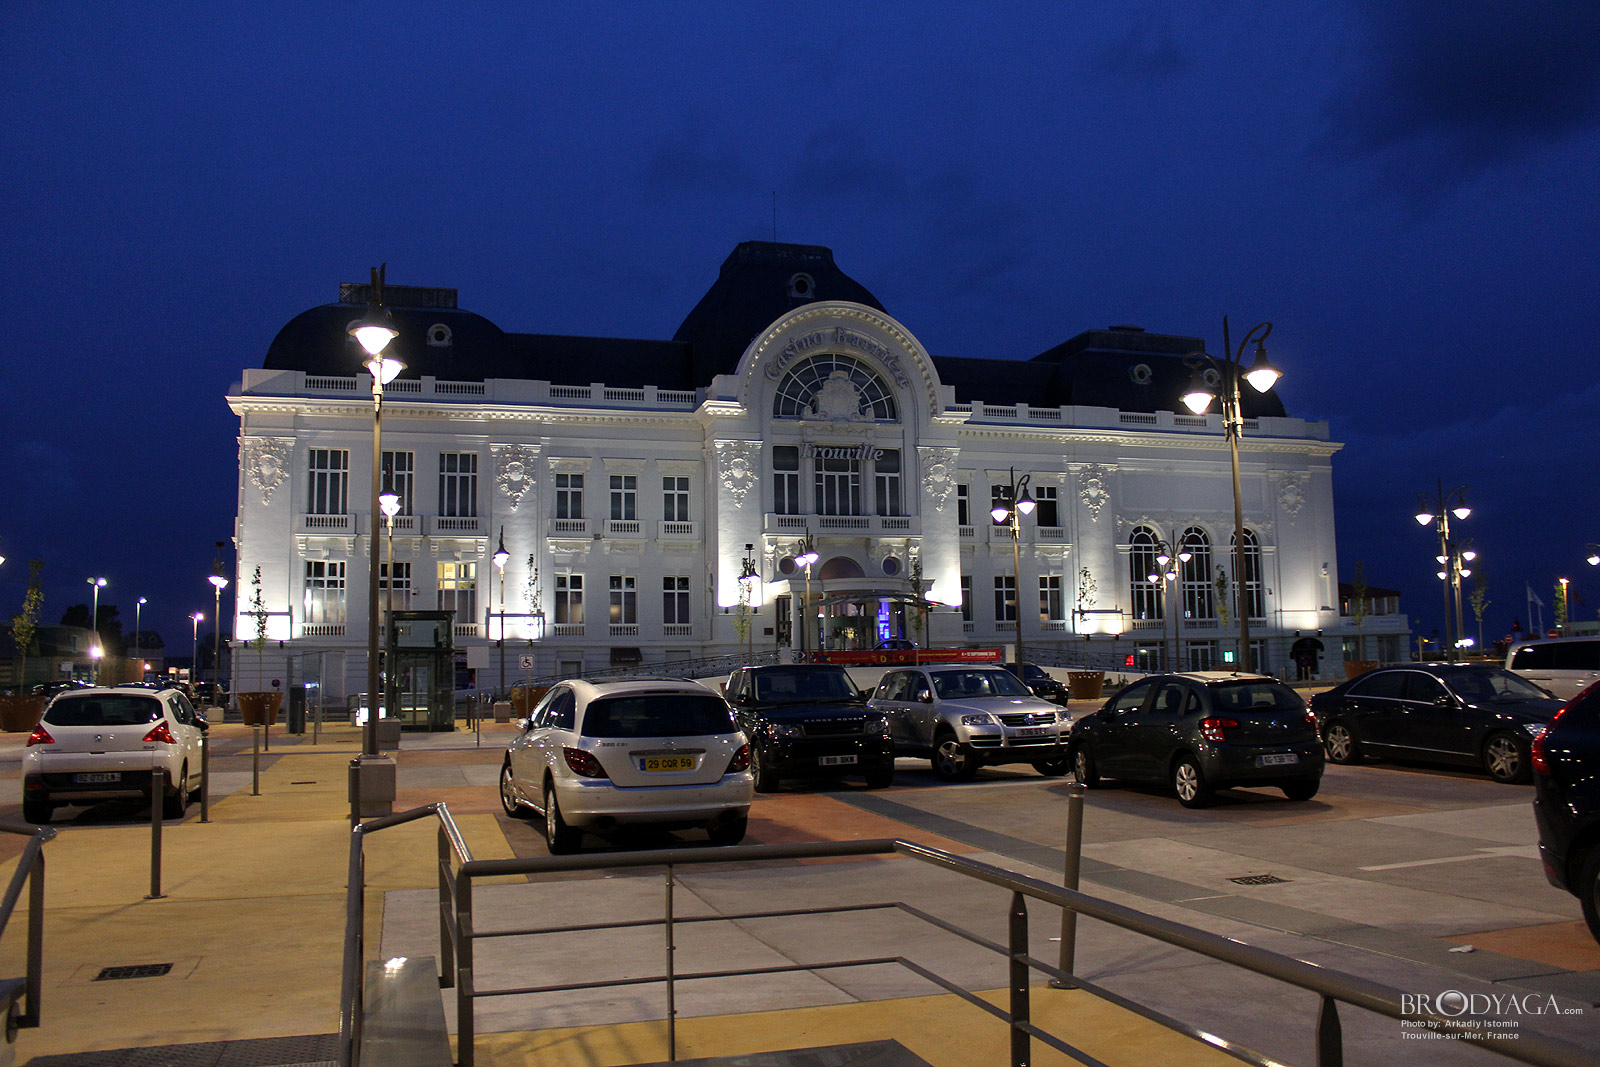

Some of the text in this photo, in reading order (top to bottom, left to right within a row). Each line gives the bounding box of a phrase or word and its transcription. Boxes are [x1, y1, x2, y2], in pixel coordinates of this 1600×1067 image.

[764, 333, 825, 382] Casino
[801, 440, 884, 461] Trouville
[648, 758, 692, 768] 29 CQR 59
